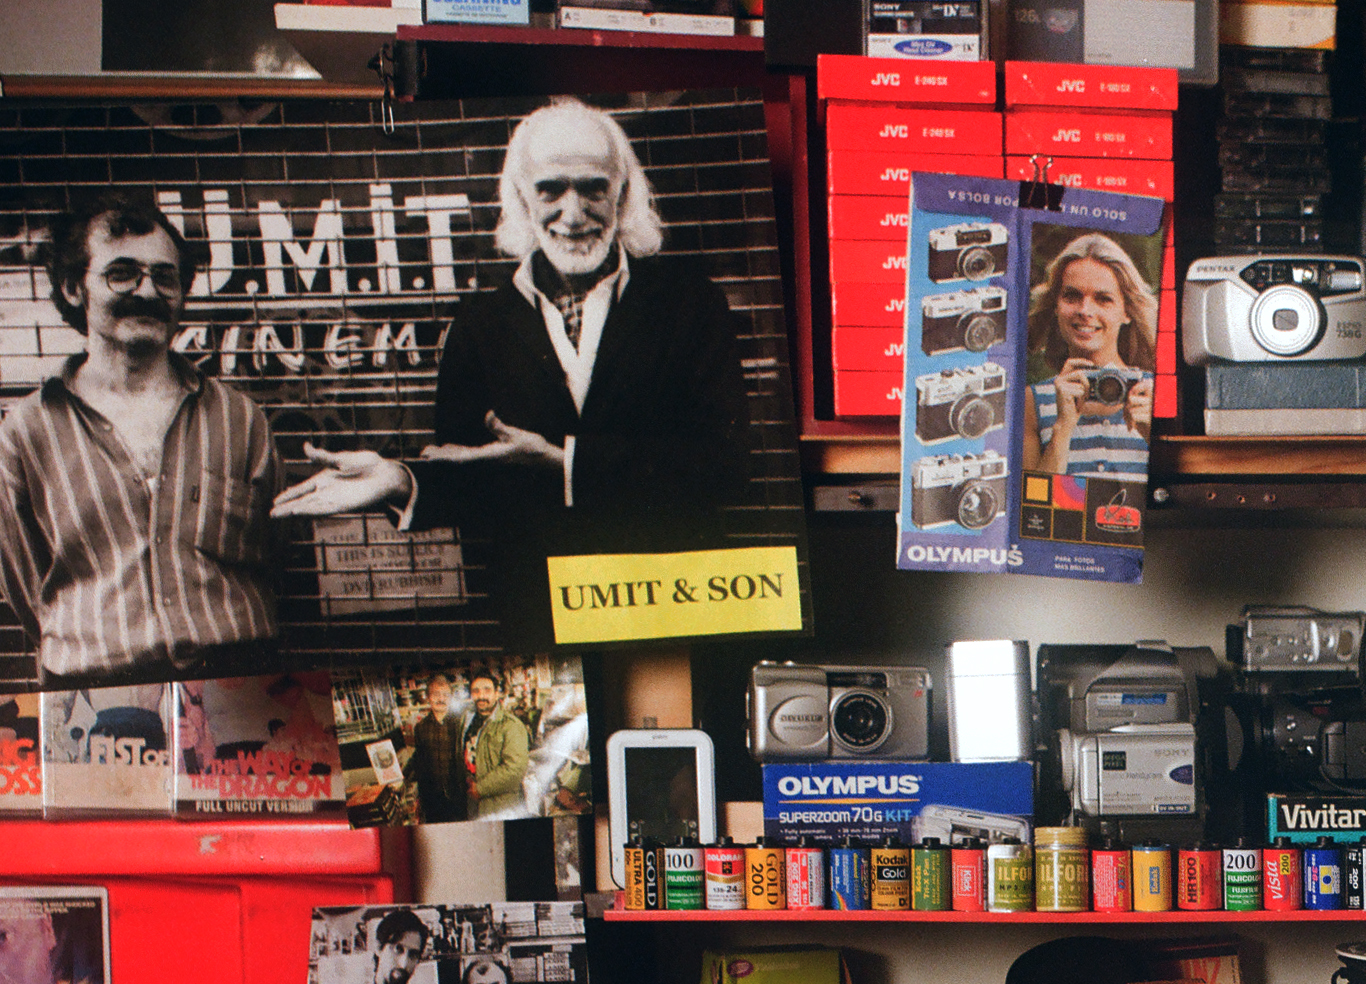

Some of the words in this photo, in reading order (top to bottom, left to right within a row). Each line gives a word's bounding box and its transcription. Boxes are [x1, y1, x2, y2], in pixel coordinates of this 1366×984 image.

[871, 73, 901, 86] JVC
[1057, 80, 1086, 93] JVC
[879, 125, 908, 138] JVC
[1053, 129, 1081, 142] JVC
[880, 169, 909, 181] JVC
[1054, 173, 1082, 187] JVC
[880, 214, 909, 226] JVC
[1196, 265, 1236, 274] PENTAX
[885, 300, 905, 311] JV
[884, 344, 904, 355] JV
[886, 388, 904, 399] JV
[907, 545, 1024, 566] OLYMPUS
[558, 580, 661, 611] UMIT
[672, 578, 700, 604] &
[707, 573, 785, 602] SON
[90, 735, 146, 766] FIST
[237, 750, 293, 776] WAY
[219, 775, 333, 799] DRAGON
[778, 775, 921, 796] OLYMPUS
[196, 801, 221, 812] FULL
[225, 801, 263, 812] UNCUT
[266, 801, 314, 812] VERSION
[885, 809, 912, 822] KIT
[1281, 803, 1366, 829] Vivitar
[633, 850, 643, 886] ULTRA
[667, 853, 694, 870] 100
[877, 854, 908, 866] Kodak
[1226, 854, 1256, 870] 200
[1280, 855, 1290, 874] 200
[646, 851, 657, 906] GOLD
[752, 863, 765, 896] 200
[766, 853, 779, 905] GOLD
[882, 867, 906, 880] Gold
[963, 869, 972, 892] Klick
[1117, 856, 1127, 889] vista
[1266, 860, 1284, 899] vista
[1351, 868, 1359, 889] 200
[634, 887, 643, 907] 400
